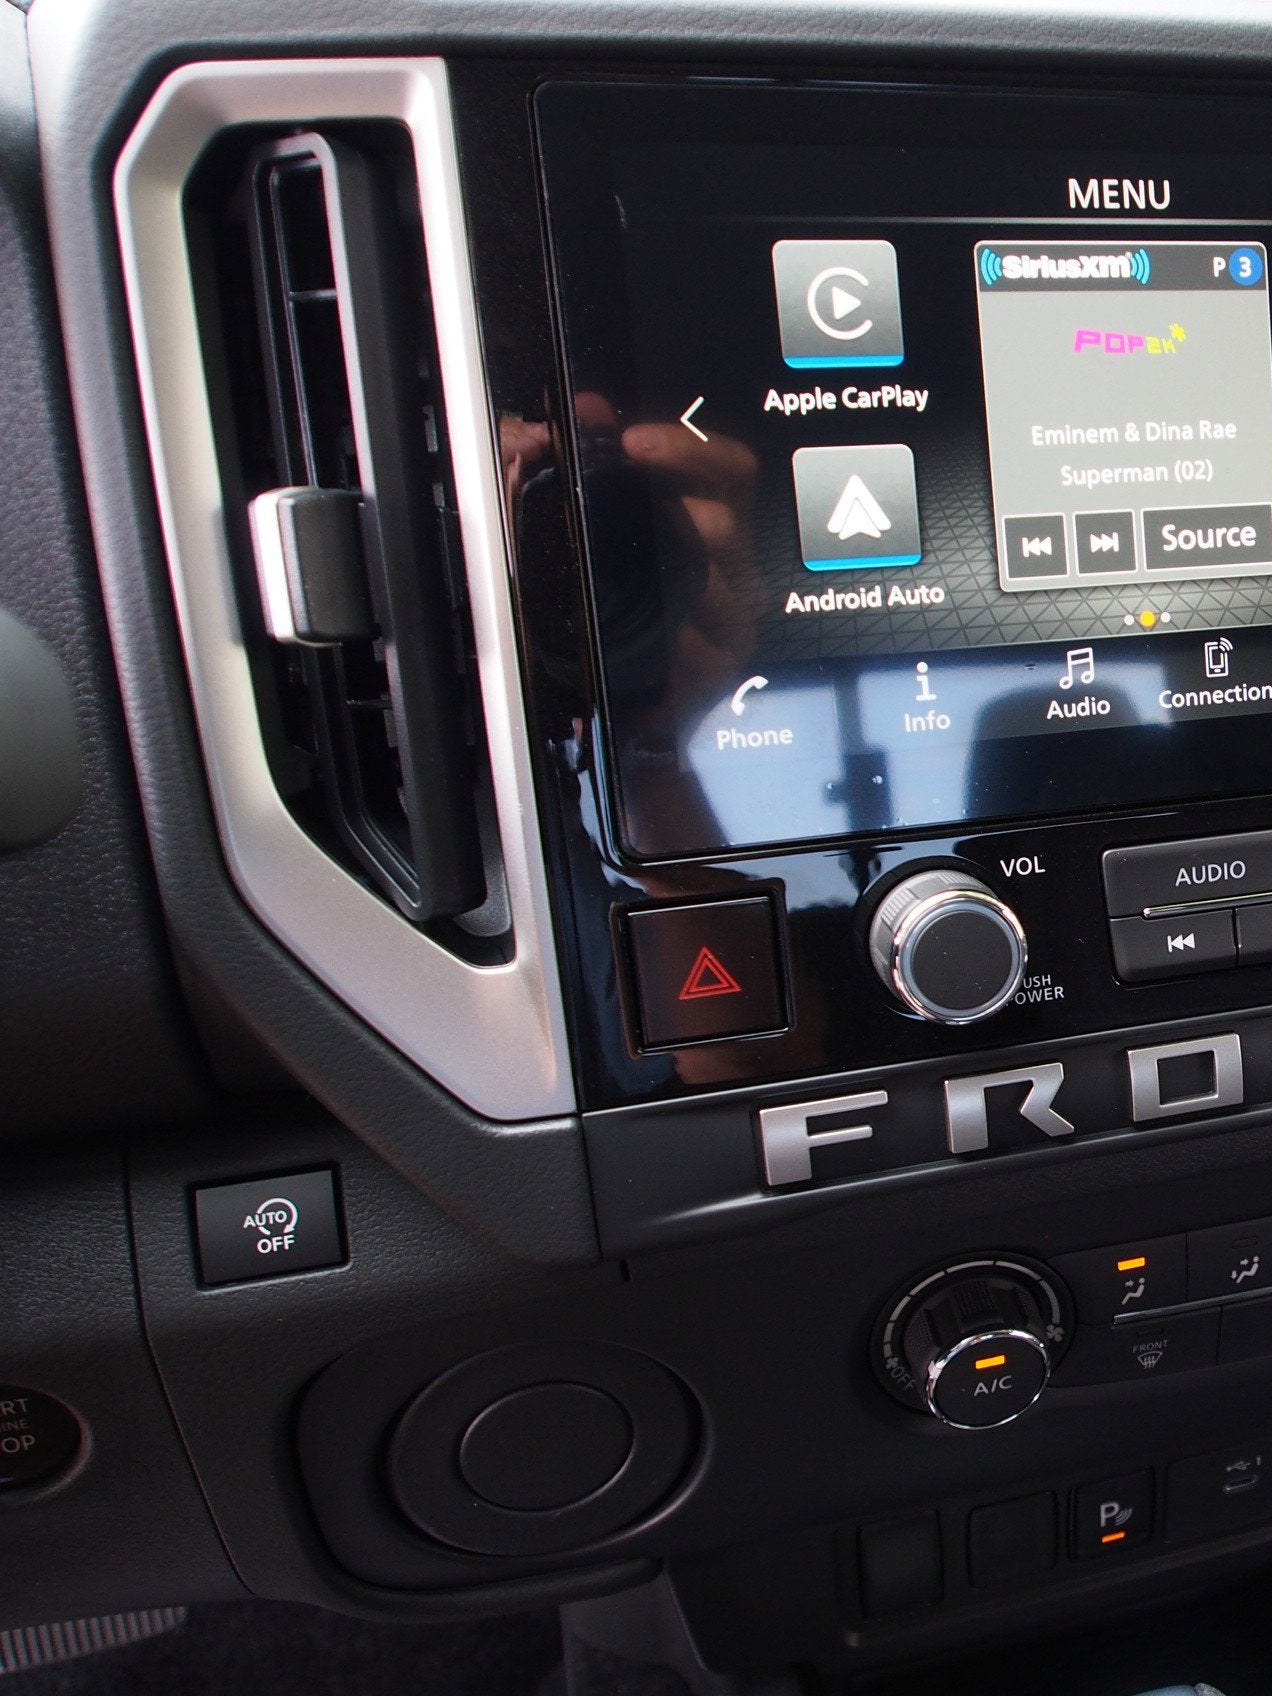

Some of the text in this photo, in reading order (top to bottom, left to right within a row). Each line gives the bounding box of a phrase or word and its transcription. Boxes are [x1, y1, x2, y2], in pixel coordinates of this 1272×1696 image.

[1067, 177, 1172, 211] MENU
[1212, 256, 1252, 278] P 3
[763, 385, 930, 416] Apple CarPlay
[1030, 419, 1237, 447] Eminem & Dina Rae
[1059, 458, 1214, 489] Superman (02)
[1161, 523, 1258, 552] Source
[784, 585, 946, 615] Android Auto
[1045, 697, 1112, 720] Audio
[904, 709, 952, 733] Info
[716, 727, 794, 751] Phone
[999, 855, 1046, 878] VOL
[1174, 859, 1247, 888] AUDIO
[1021, 974, 1052, 989] USH
[1011, 986, 1065, 1005] OWER
[242, 1209, 288, 1229] AUTO
[256, 1234, 296, 1254] OFF
[1131, 1339, 1169, 1353] FRONT
[889, 1366, 917, 1392] OFF
[972, 1374, 1014, 1398] A/C
